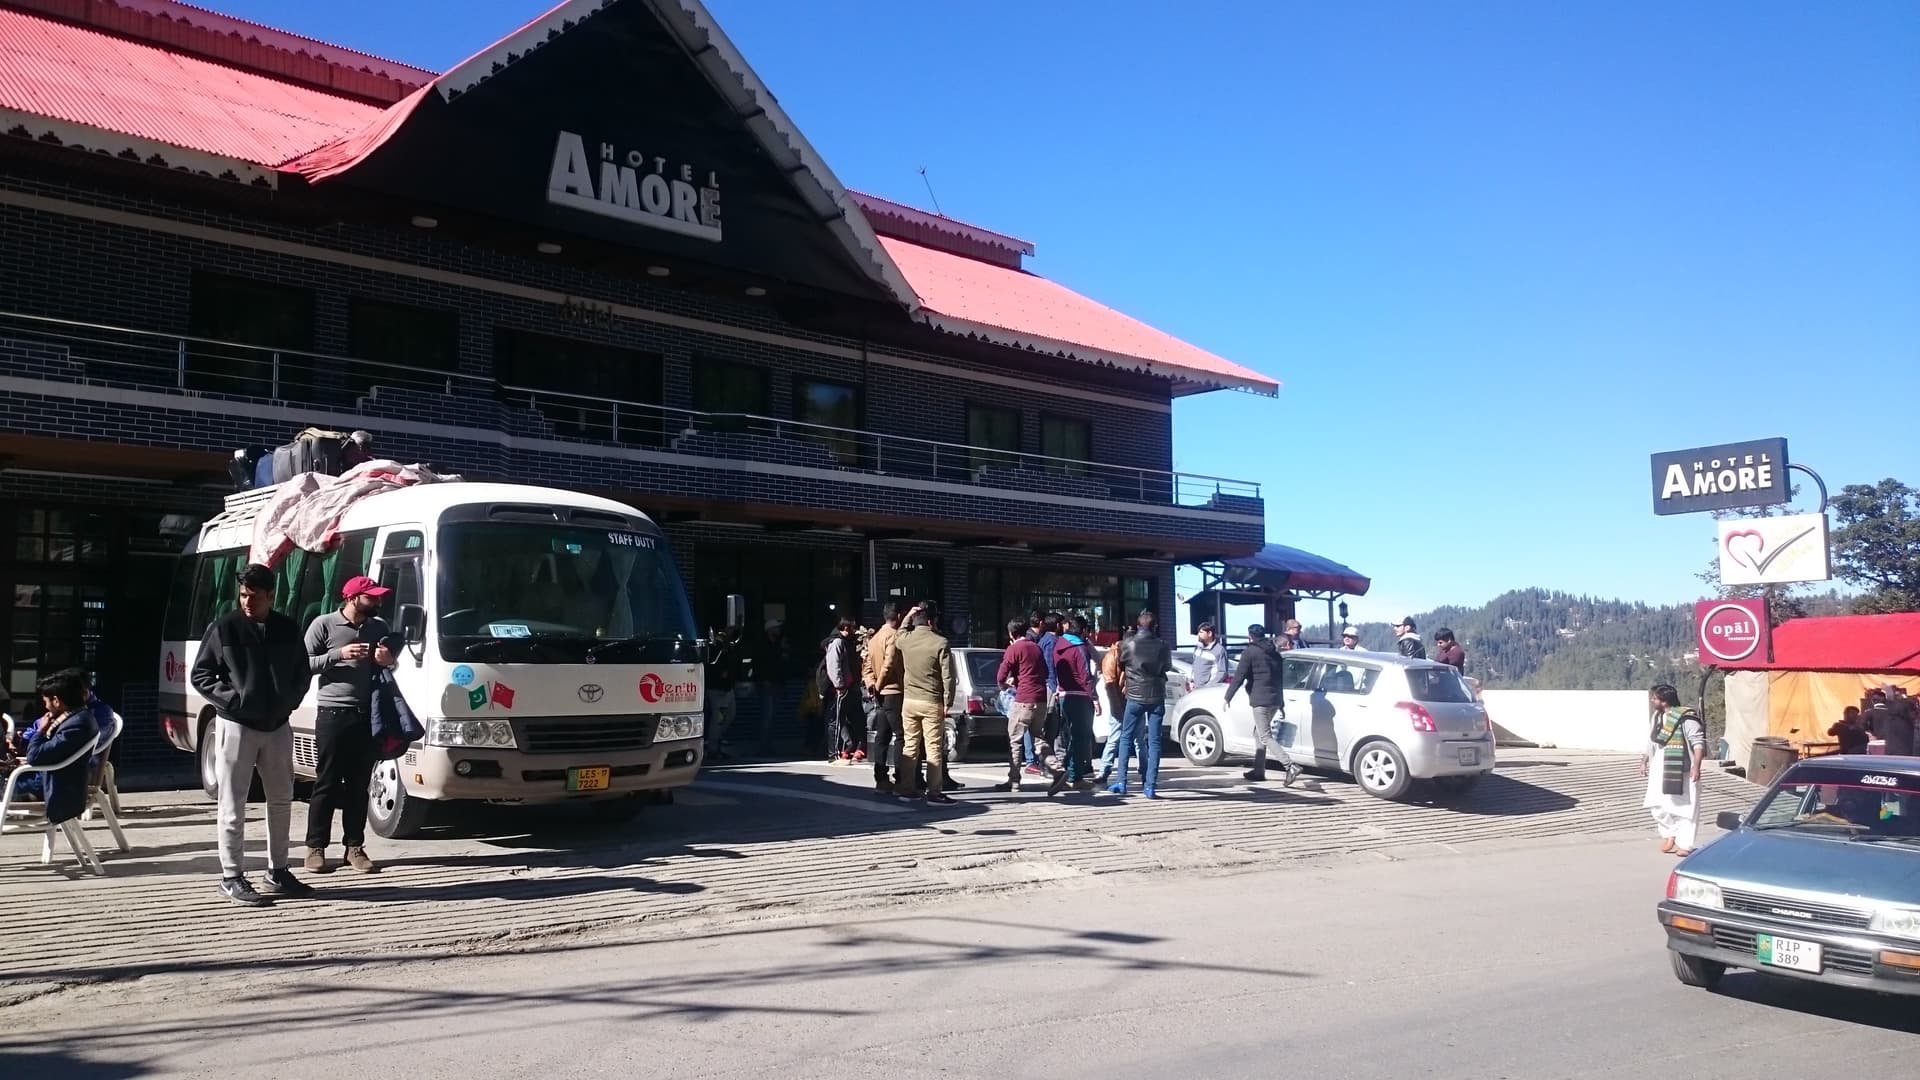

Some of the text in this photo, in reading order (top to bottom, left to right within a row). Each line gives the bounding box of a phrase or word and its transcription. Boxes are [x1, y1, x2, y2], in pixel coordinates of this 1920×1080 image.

[601, 142, 719, 188] HOTEL
[549, 130, 721, 230] AMORE
[1693, 453, 1771, 471] HOTEL
[1661, 463, 1772, 500] AMORE
[608, 532, 655, 549] STAFF DUTY
[580, 769, 597, 779] LES
[1776, 939, 1800, 952] RIP
[1777, 952, 1800, 966] 389
